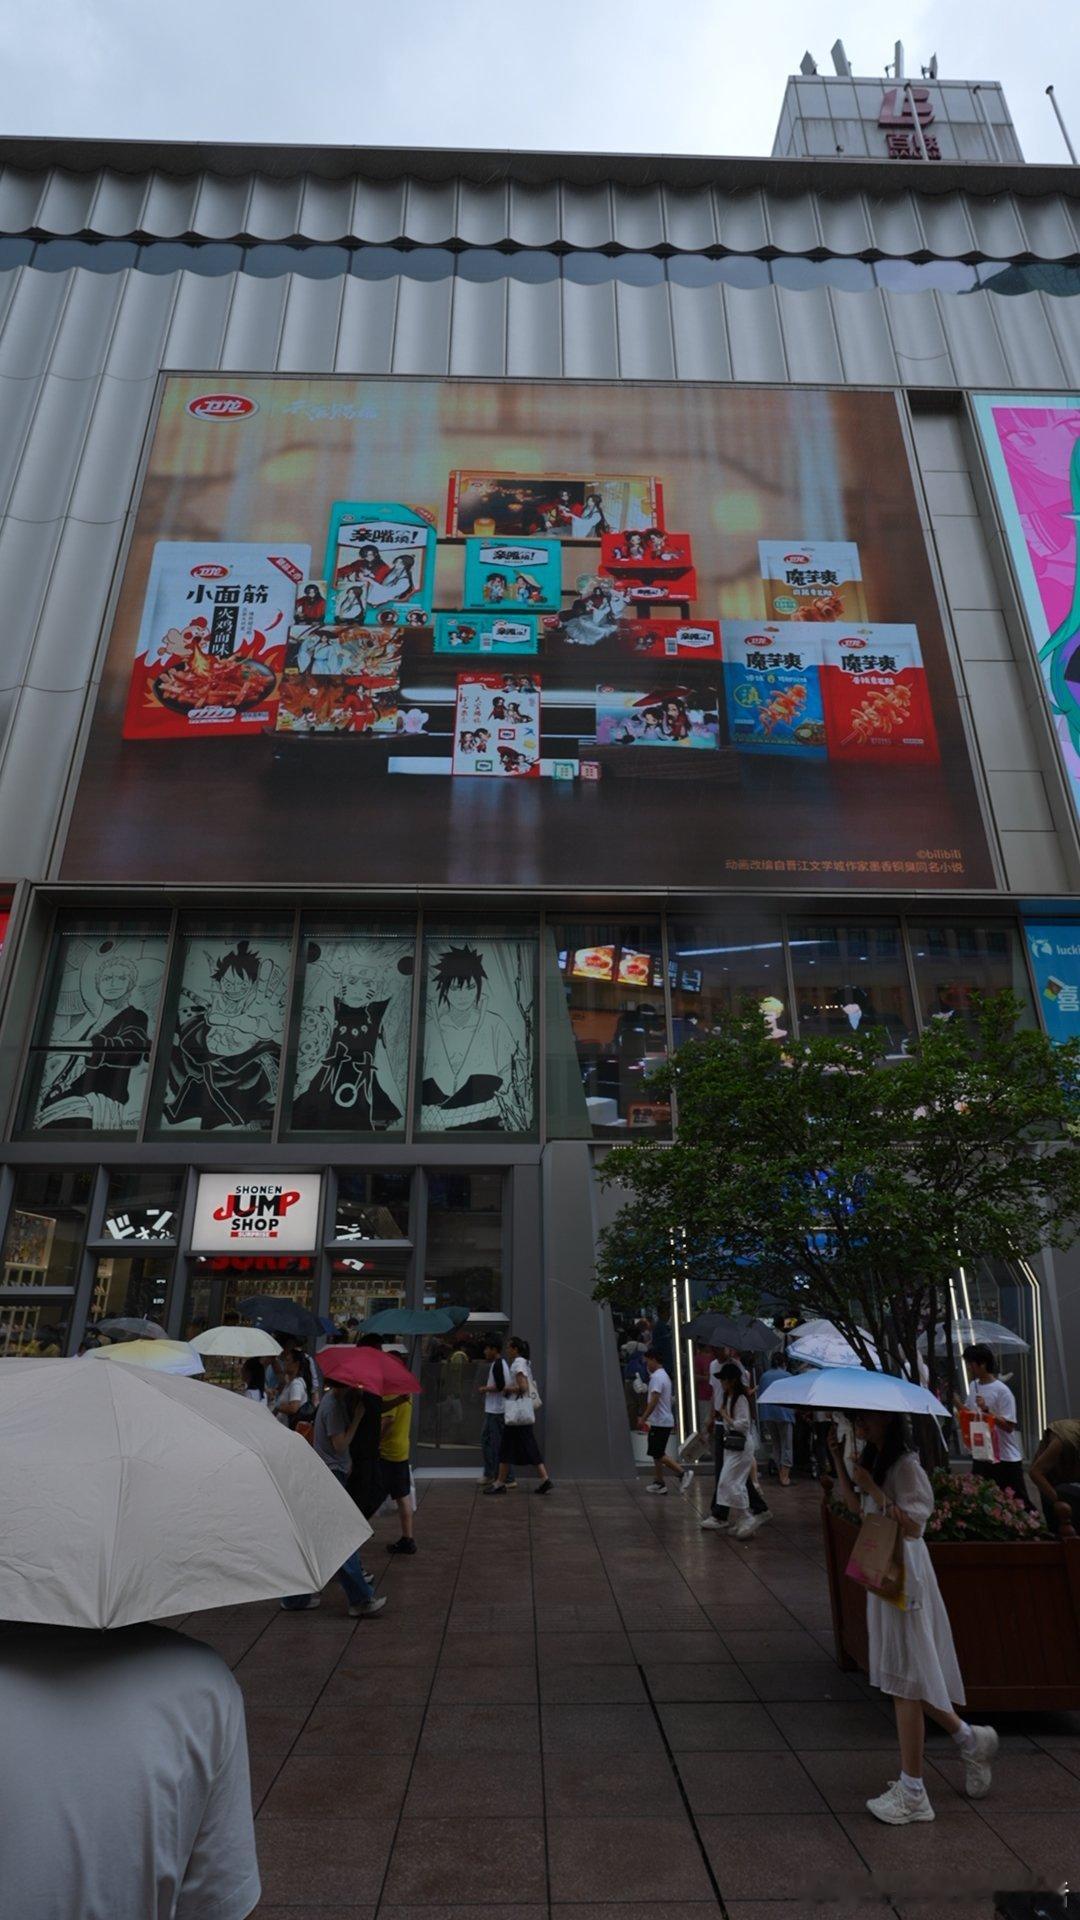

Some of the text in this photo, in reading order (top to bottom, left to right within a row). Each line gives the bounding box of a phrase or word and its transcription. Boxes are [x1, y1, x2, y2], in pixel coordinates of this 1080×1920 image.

[786, 569, 839, 586] 魔芋爽
[186, 584, 268, 604] 小面筋
[212, 608, 234, 656] 火鸡面味
[746, 652, 804, 671] 魔芋爽
[841, 653, 898, 673] 魔芋爽
[236, 1185, 282, 1194] SHONEN
[213, 1191, 300, 1221] JUMP
[231, 1218, 279, 1231] SHOP
